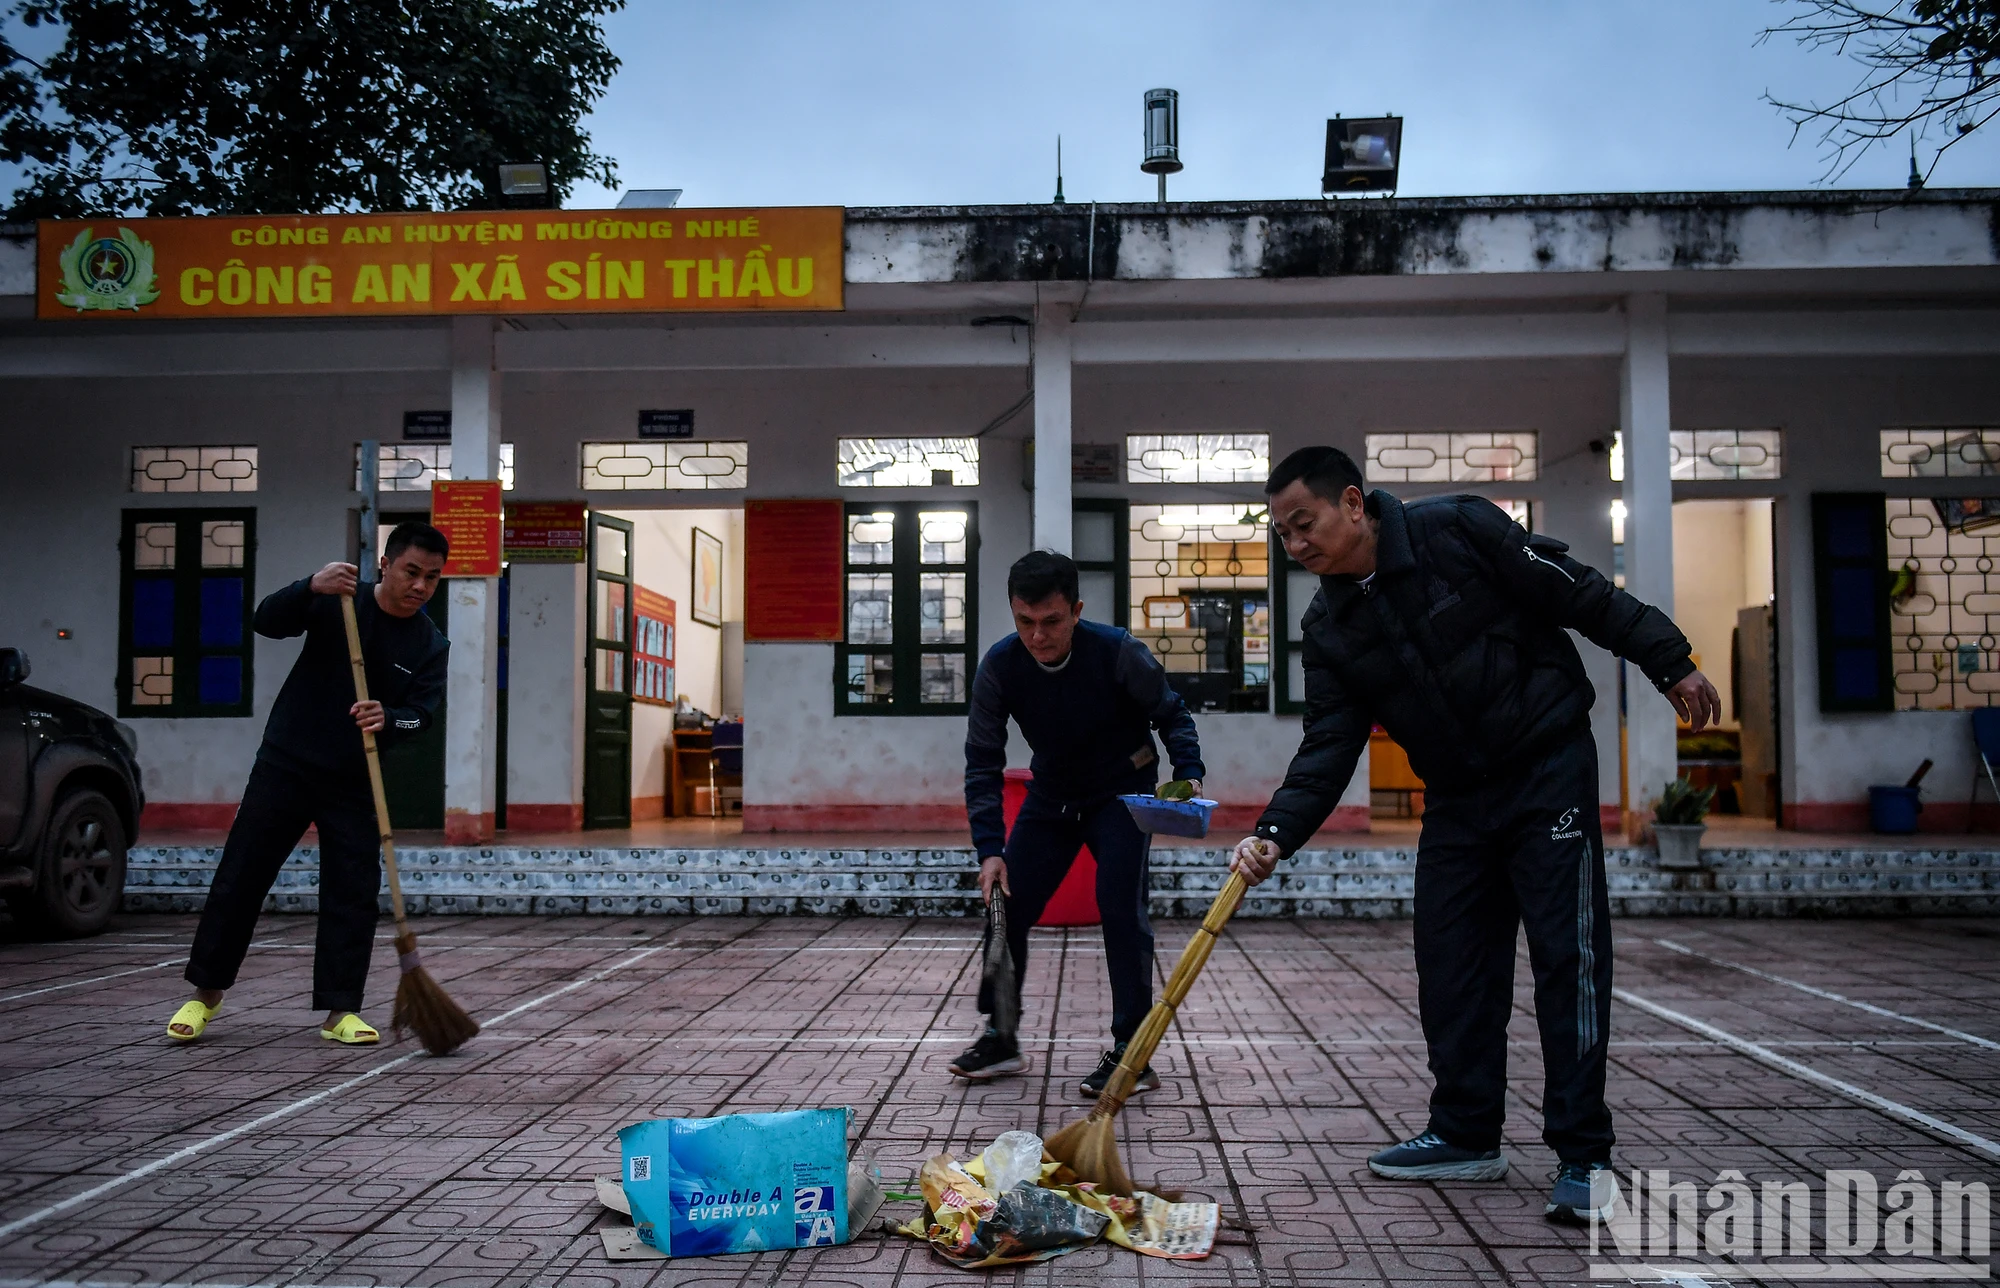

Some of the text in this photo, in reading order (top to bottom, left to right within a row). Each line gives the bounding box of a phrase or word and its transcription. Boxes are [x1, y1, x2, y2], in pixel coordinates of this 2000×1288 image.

[231, 216, 760, 246] CÔNG AN HUYỆN MƯỜNG NHÉ
[180, 244, 814, 305] CÔNG AN XÃ SÍN THẦU
[1551, 830, 1582, 840] COLLECTION
[690, 1186, 782, 1206] Double A
[688, 1203, 781, 1221] EVERYDAY
